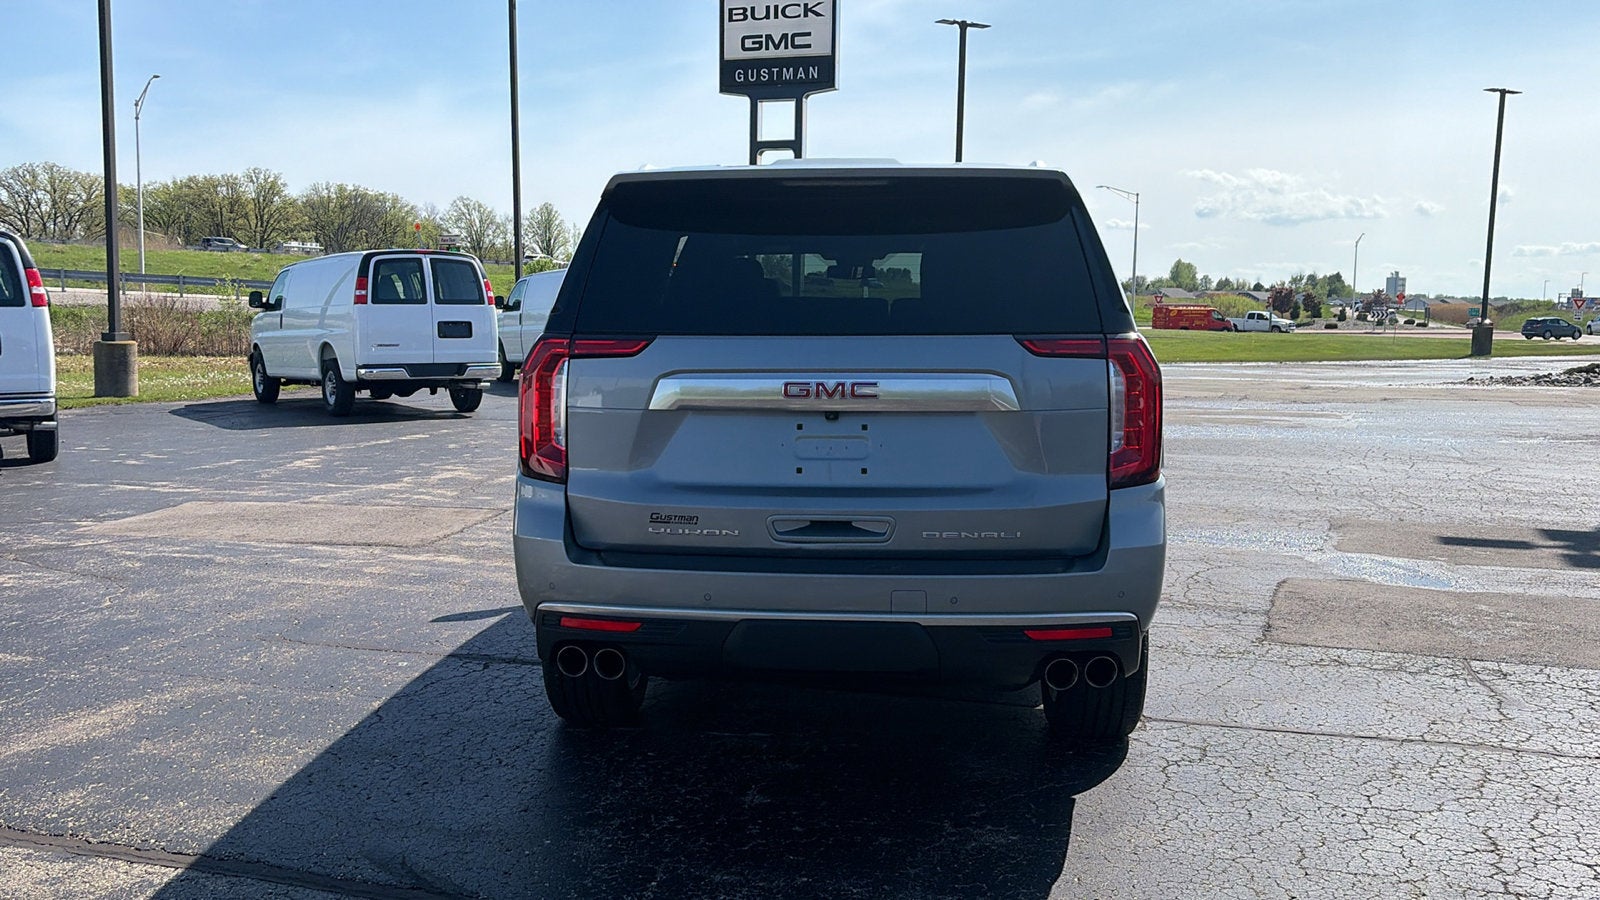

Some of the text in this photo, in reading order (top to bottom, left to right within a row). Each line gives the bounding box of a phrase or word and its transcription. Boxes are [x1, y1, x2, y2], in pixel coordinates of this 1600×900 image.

[728, 2, 825, 22] BUICK
[741, 32, 812, 52] GMC
[735, 66, 818, 82] GUSTMAN
[783, 381, 878, 399] GMC
[648, 527, 739, 536] YUKON
